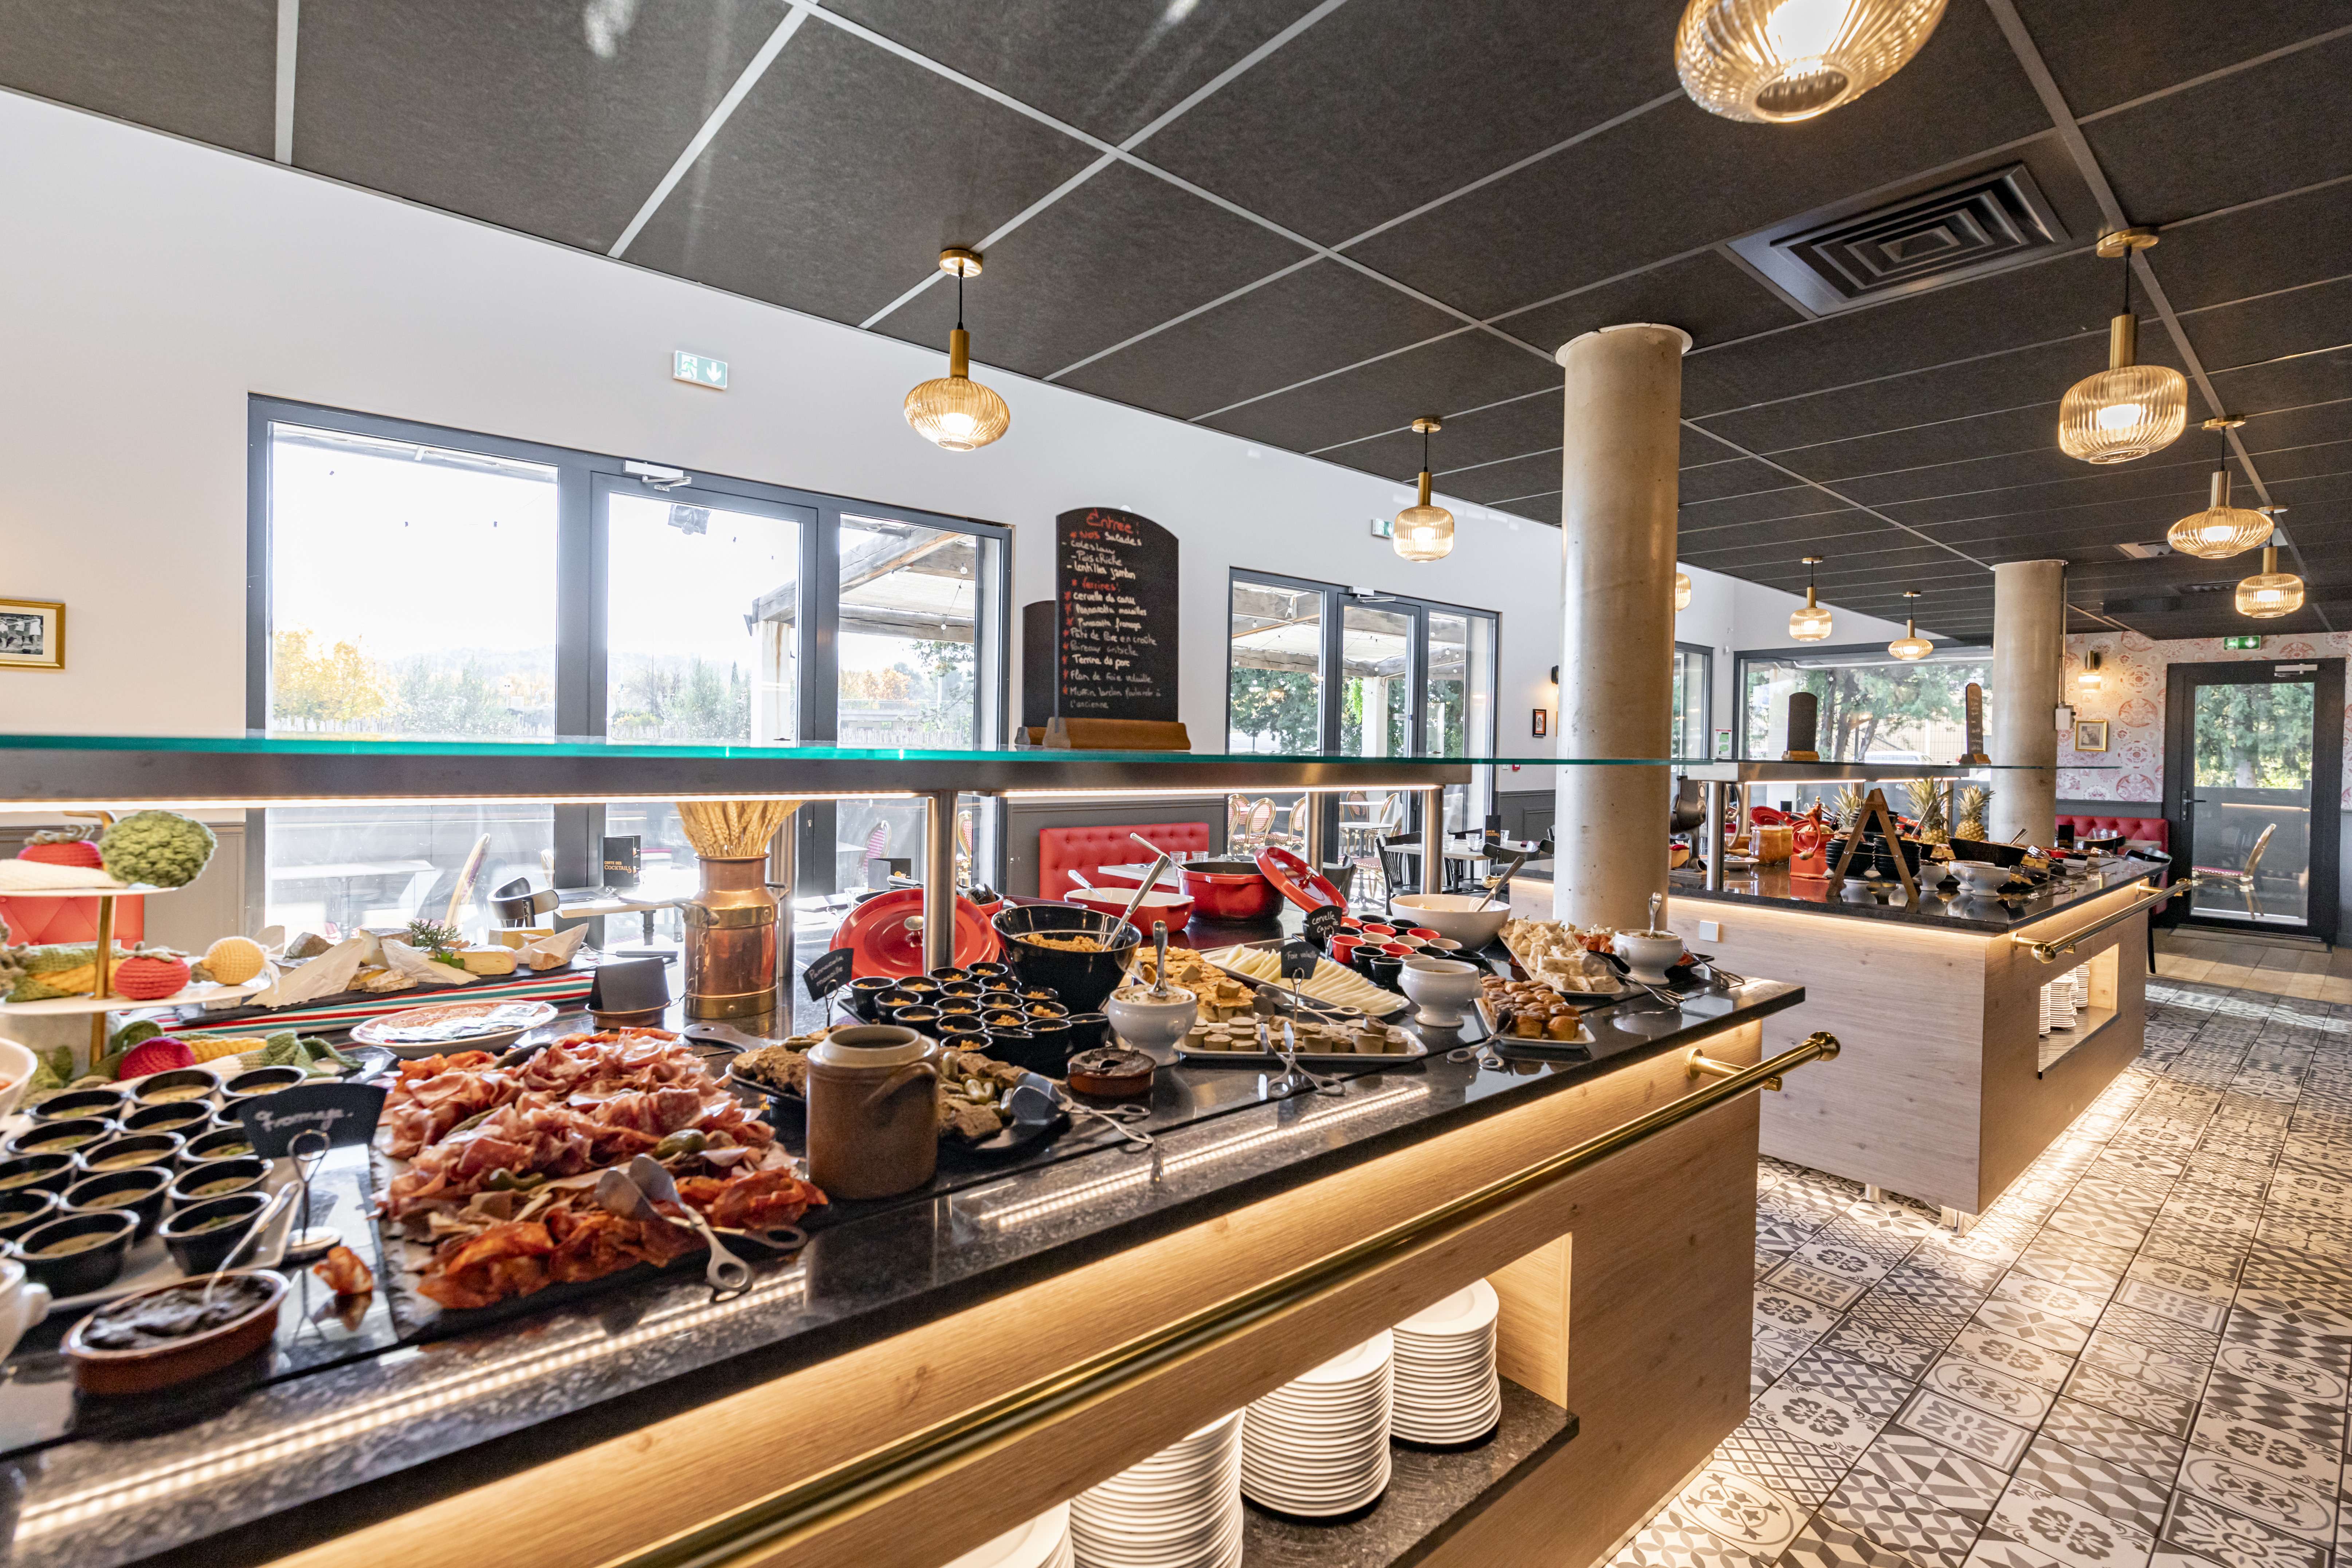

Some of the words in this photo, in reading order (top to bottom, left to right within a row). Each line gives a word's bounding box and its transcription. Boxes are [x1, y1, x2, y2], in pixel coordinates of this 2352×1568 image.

[1104, 531, 1142, 546] Salades
[1105, 593, 1115, 603] de
[1090, 629, 1100, 641] de
[1072, 653, 1102, 665] Terrine
[1104, 656, 1113, 665] de
[1115, 659, 1130, 670] porc
[1070, 668, 1090, 681] Flan
[1093, 671, 1102, 681] de
